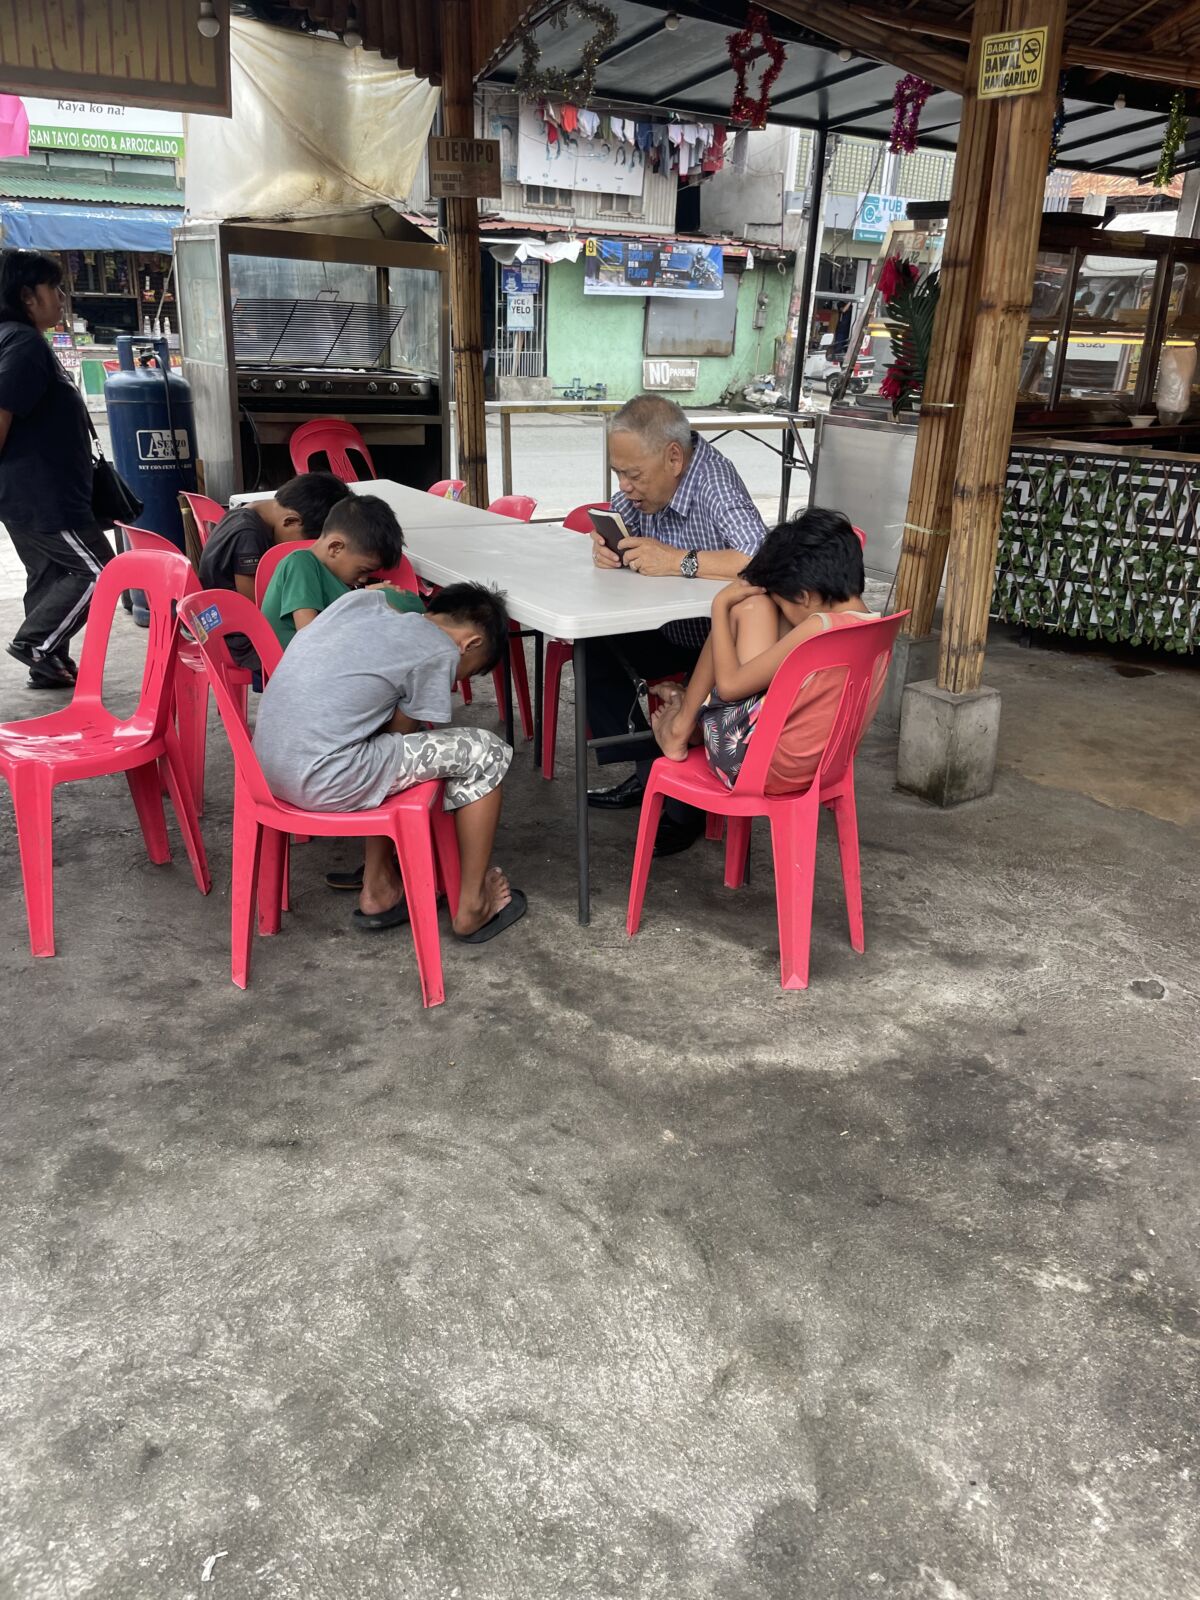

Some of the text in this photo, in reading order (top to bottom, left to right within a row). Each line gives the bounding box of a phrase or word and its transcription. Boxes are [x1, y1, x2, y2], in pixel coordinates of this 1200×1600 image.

[986, 39, 1020, 54] BABALA
[985, 53, 1021, 73] BAWAL
[983, 68, 1037, 91] MANIGARILYO
[57, 100, 126, 116] Kaya ko na!
[51, 130, 80, 147] TAYO!
[81, 135, 109, 150] GOTO
[110, 137, 118, 150] &
[119, 137, 178, 155] ARROZCALDO
[436, 141, 493, 163] LIEMPO
[882, 198, 902, 212] TUB
[588, 239, 594, 254] 9
[511, 306, 531, 314] YELO
[649, 362, 695, 385] NO PARKING
